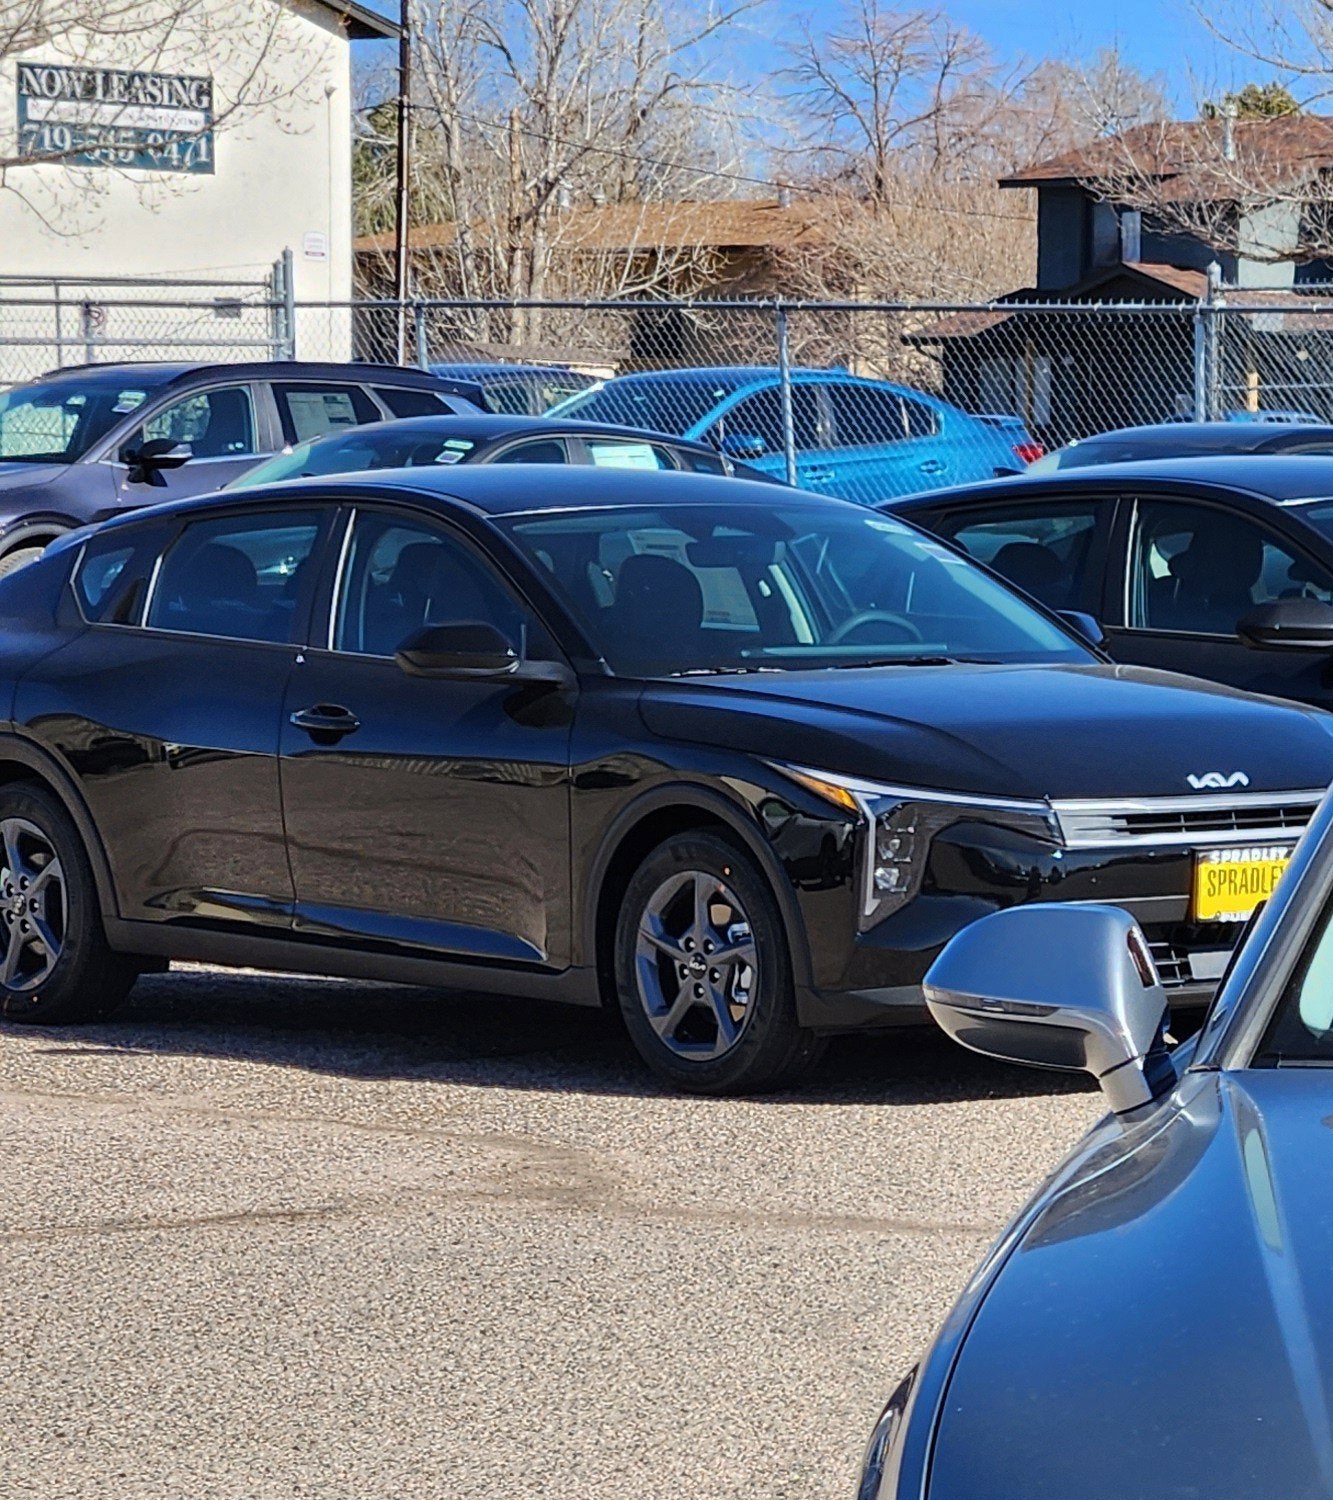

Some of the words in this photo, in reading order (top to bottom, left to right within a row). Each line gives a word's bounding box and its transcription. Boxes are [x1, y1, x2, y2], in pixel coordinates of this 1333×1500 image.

[20, 67, 87, 99] NOW
[95, 71, 211, 109] LEASING
[1210, 847, 1288, 864] SPRADLEY
[1207, 866, 1284, 897] SPRADLE
